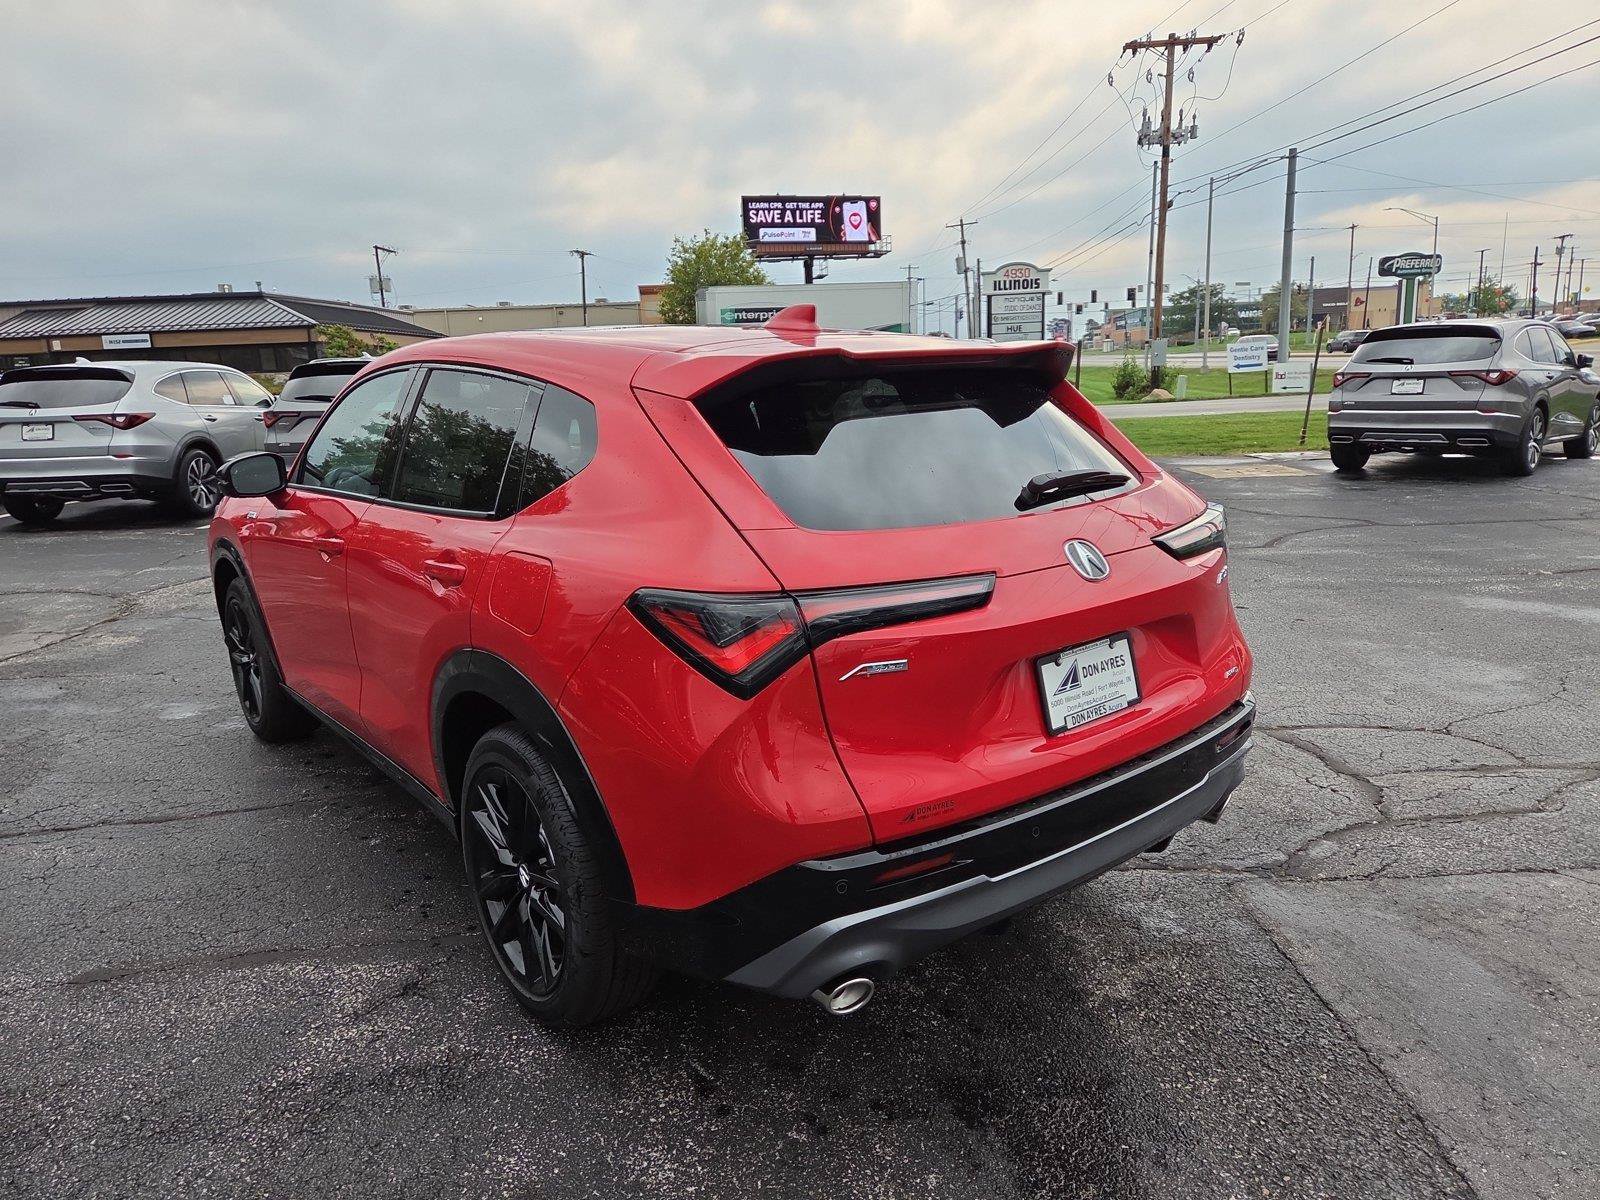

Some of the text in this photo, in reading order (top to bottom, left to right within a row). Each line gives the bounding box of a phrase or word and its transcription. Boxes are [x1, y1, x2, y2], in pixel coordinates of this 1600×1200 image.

[749, 209, 825, 223] SAVE A LIFE.
[1003, 268, 1031, 279] 4930
[993, 278, 1041, 291] ILLINOIS
[721, 310, 777, 322] enterpri
[1006, 325, 1023, 333] HUE
[1081, 654, 1126, 679] DON AYRES
[1051, 698, 1064, 708] 5000
[1082, 688, 1095, 697] Road
[1097, 684, 1108, 692] Fort
[1071, 703, 1123, 726] DON AYRES Acura
[916, 804, 932, 815] DON
[932, 800, 955, 810] AYRES
